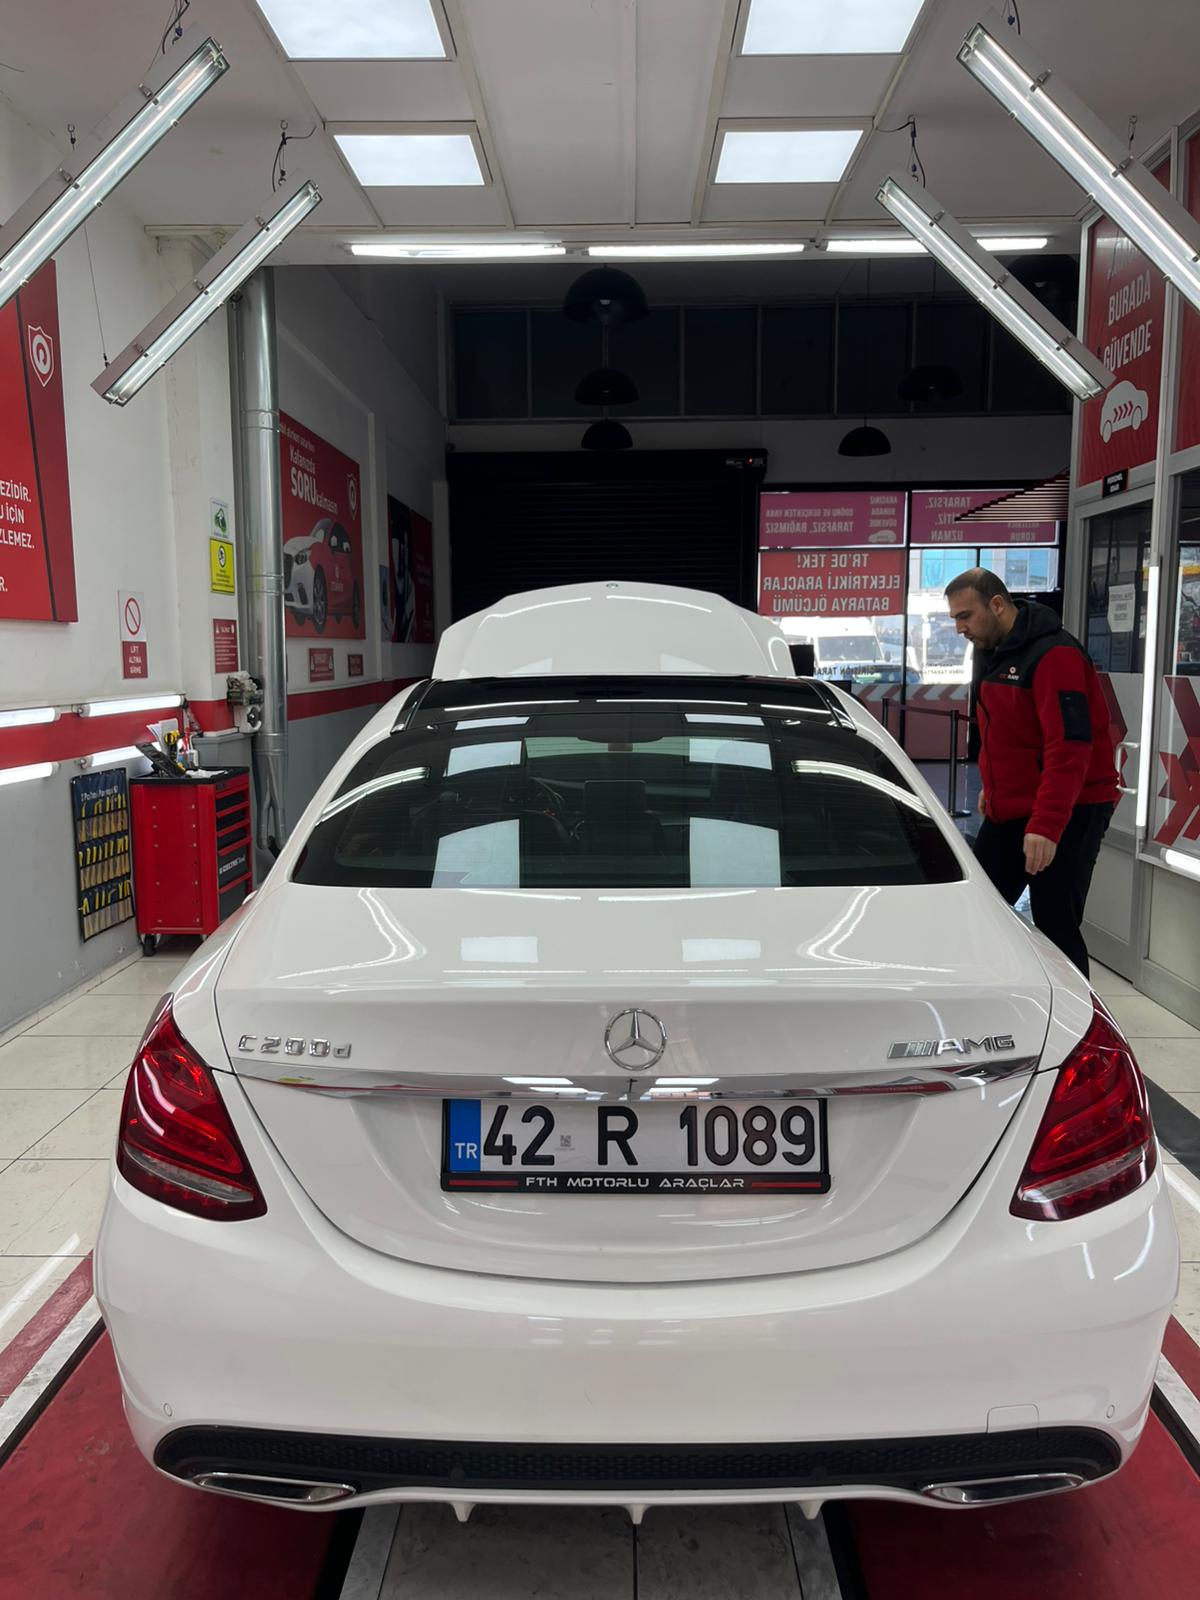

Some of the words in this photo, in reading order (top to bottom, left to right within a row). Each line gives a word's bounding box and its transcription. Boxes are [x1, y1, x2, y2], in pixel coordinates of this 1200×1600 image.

[1108, 270, 1151, 325] BURADA
[1103, 319, 1153, 372] GÜVENDE
[0, 480, 32, 502] EZİDİR.
[290, 466, 316, 506] SORU
[5, 502, 25, 524] İÇİN
[238, 1034, 353, 1059] C200d
[935, 1034, 1017, 1056] AMG
[483, 1104, 556, 1166] 42
[597, 1105, 640, 1166] R
[679, 1105, 816, 1167] 1089
[455, 1142, 479, 1159] TR
[525, 1176, 558, 1188] FTH
[566, 1177, 650, 1188] MOTORLU
[658, 1178, 746, 1192] ARAÇLAR
